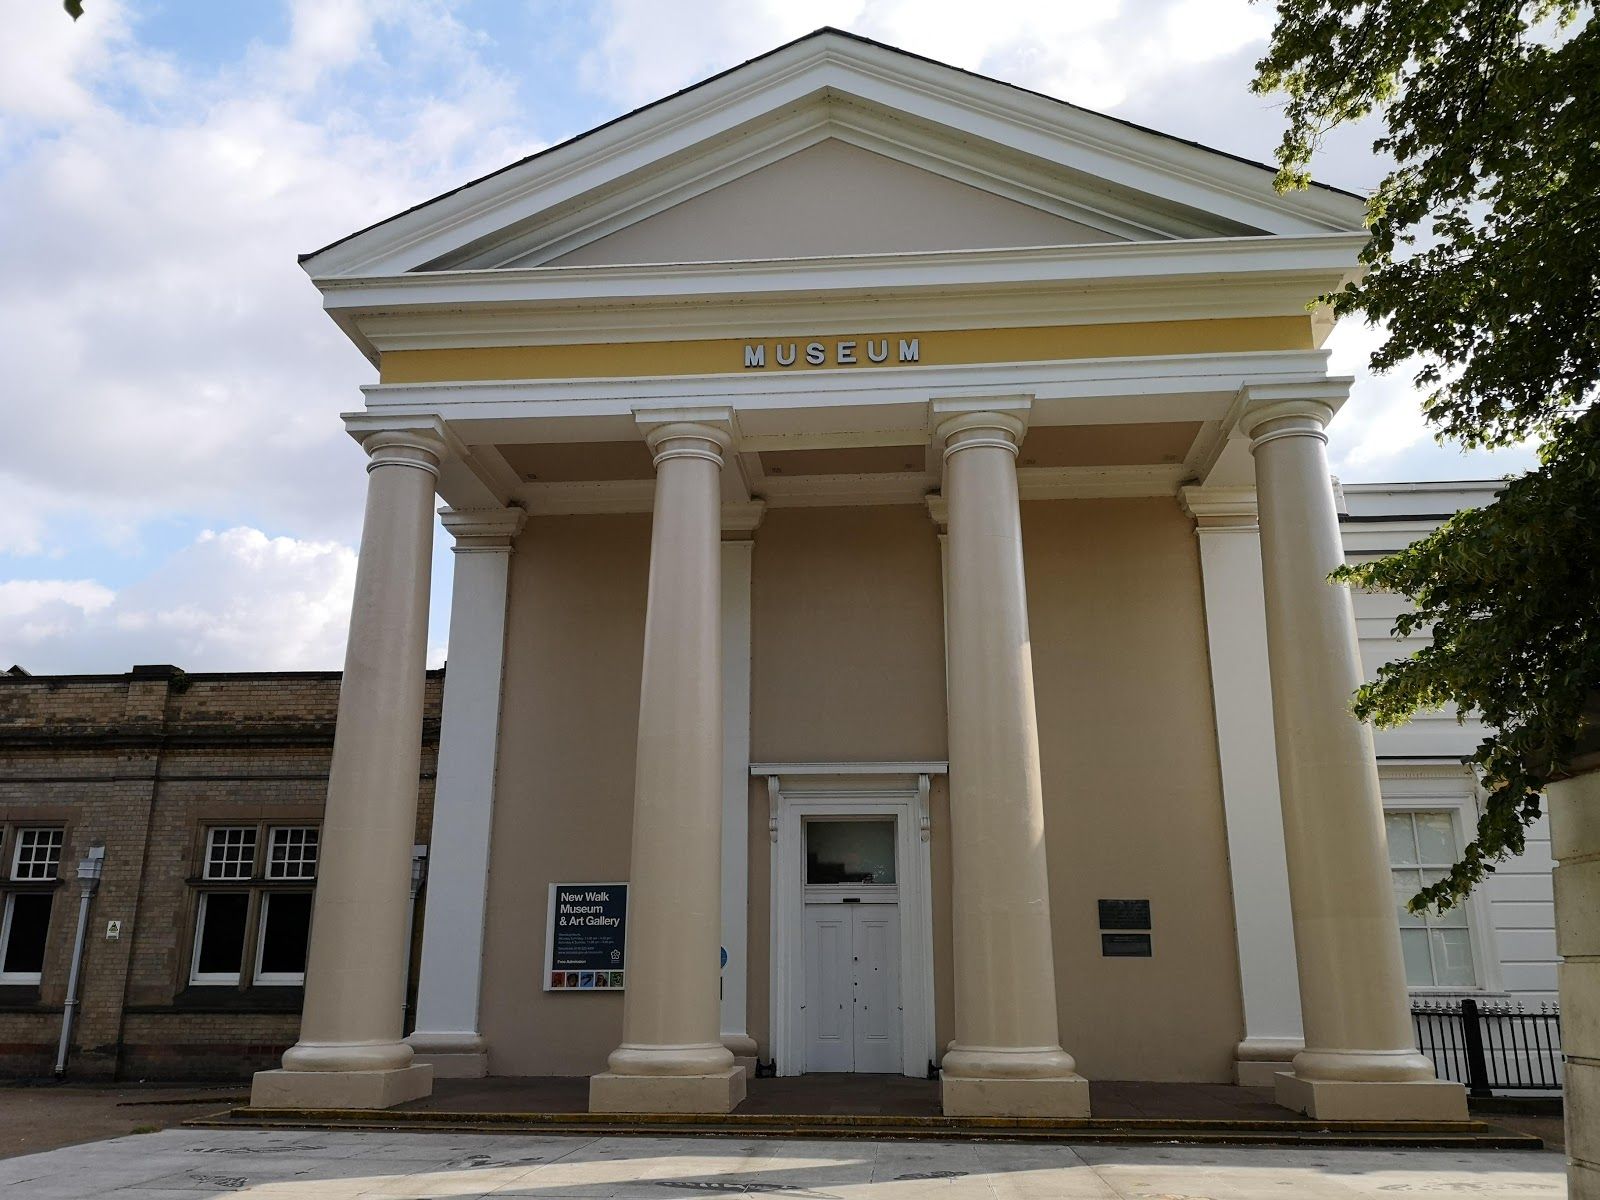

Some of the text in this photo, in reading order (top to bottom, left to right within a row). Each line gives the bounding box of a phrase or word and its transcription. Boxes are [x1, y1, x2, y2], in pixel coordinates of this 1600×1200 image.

[744, 338, 919, 368] MUSEUM
[561, 892, 609, 902] New Walk
[560, 904, 603, 913] Museum
[560, 915, 620, 927] & Art Gallery
